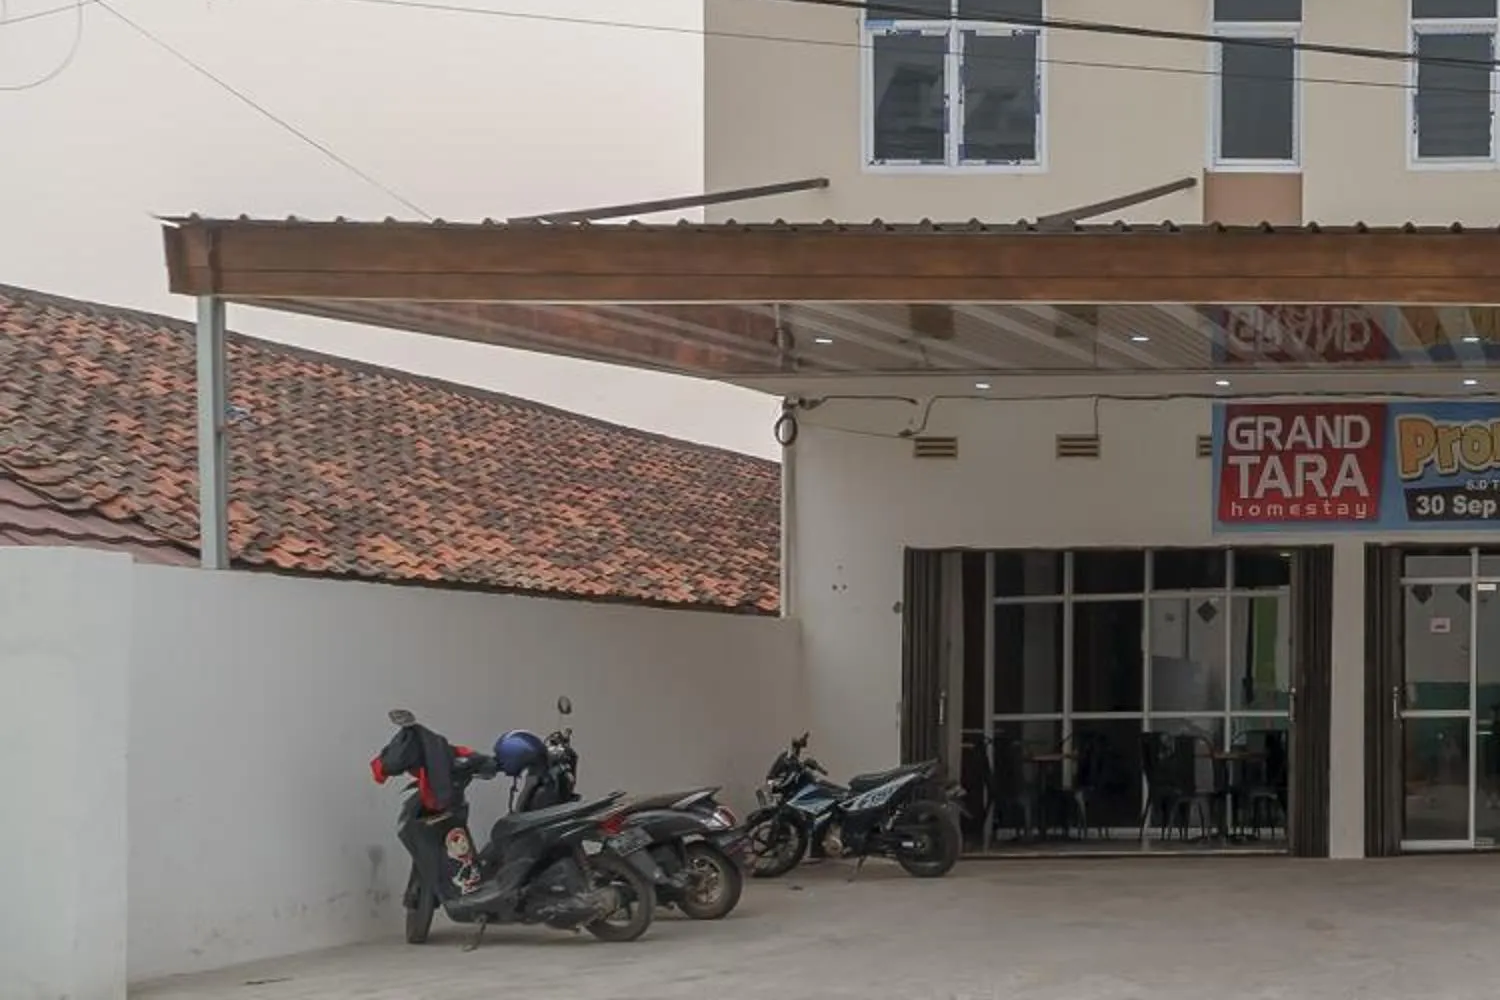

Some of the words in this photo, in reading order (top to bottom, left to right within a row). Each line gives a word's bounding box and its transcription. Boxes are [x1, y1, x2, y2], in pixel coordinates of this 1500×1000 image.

[1227, 414, 1371, 451] GRAND
[1228, 453, 1370, 499] TARA
[1231, 501, 1368, 519] homestay
[1416, 495, 1445, 515] 30
[1452, 495, 1497, 518] Sep
